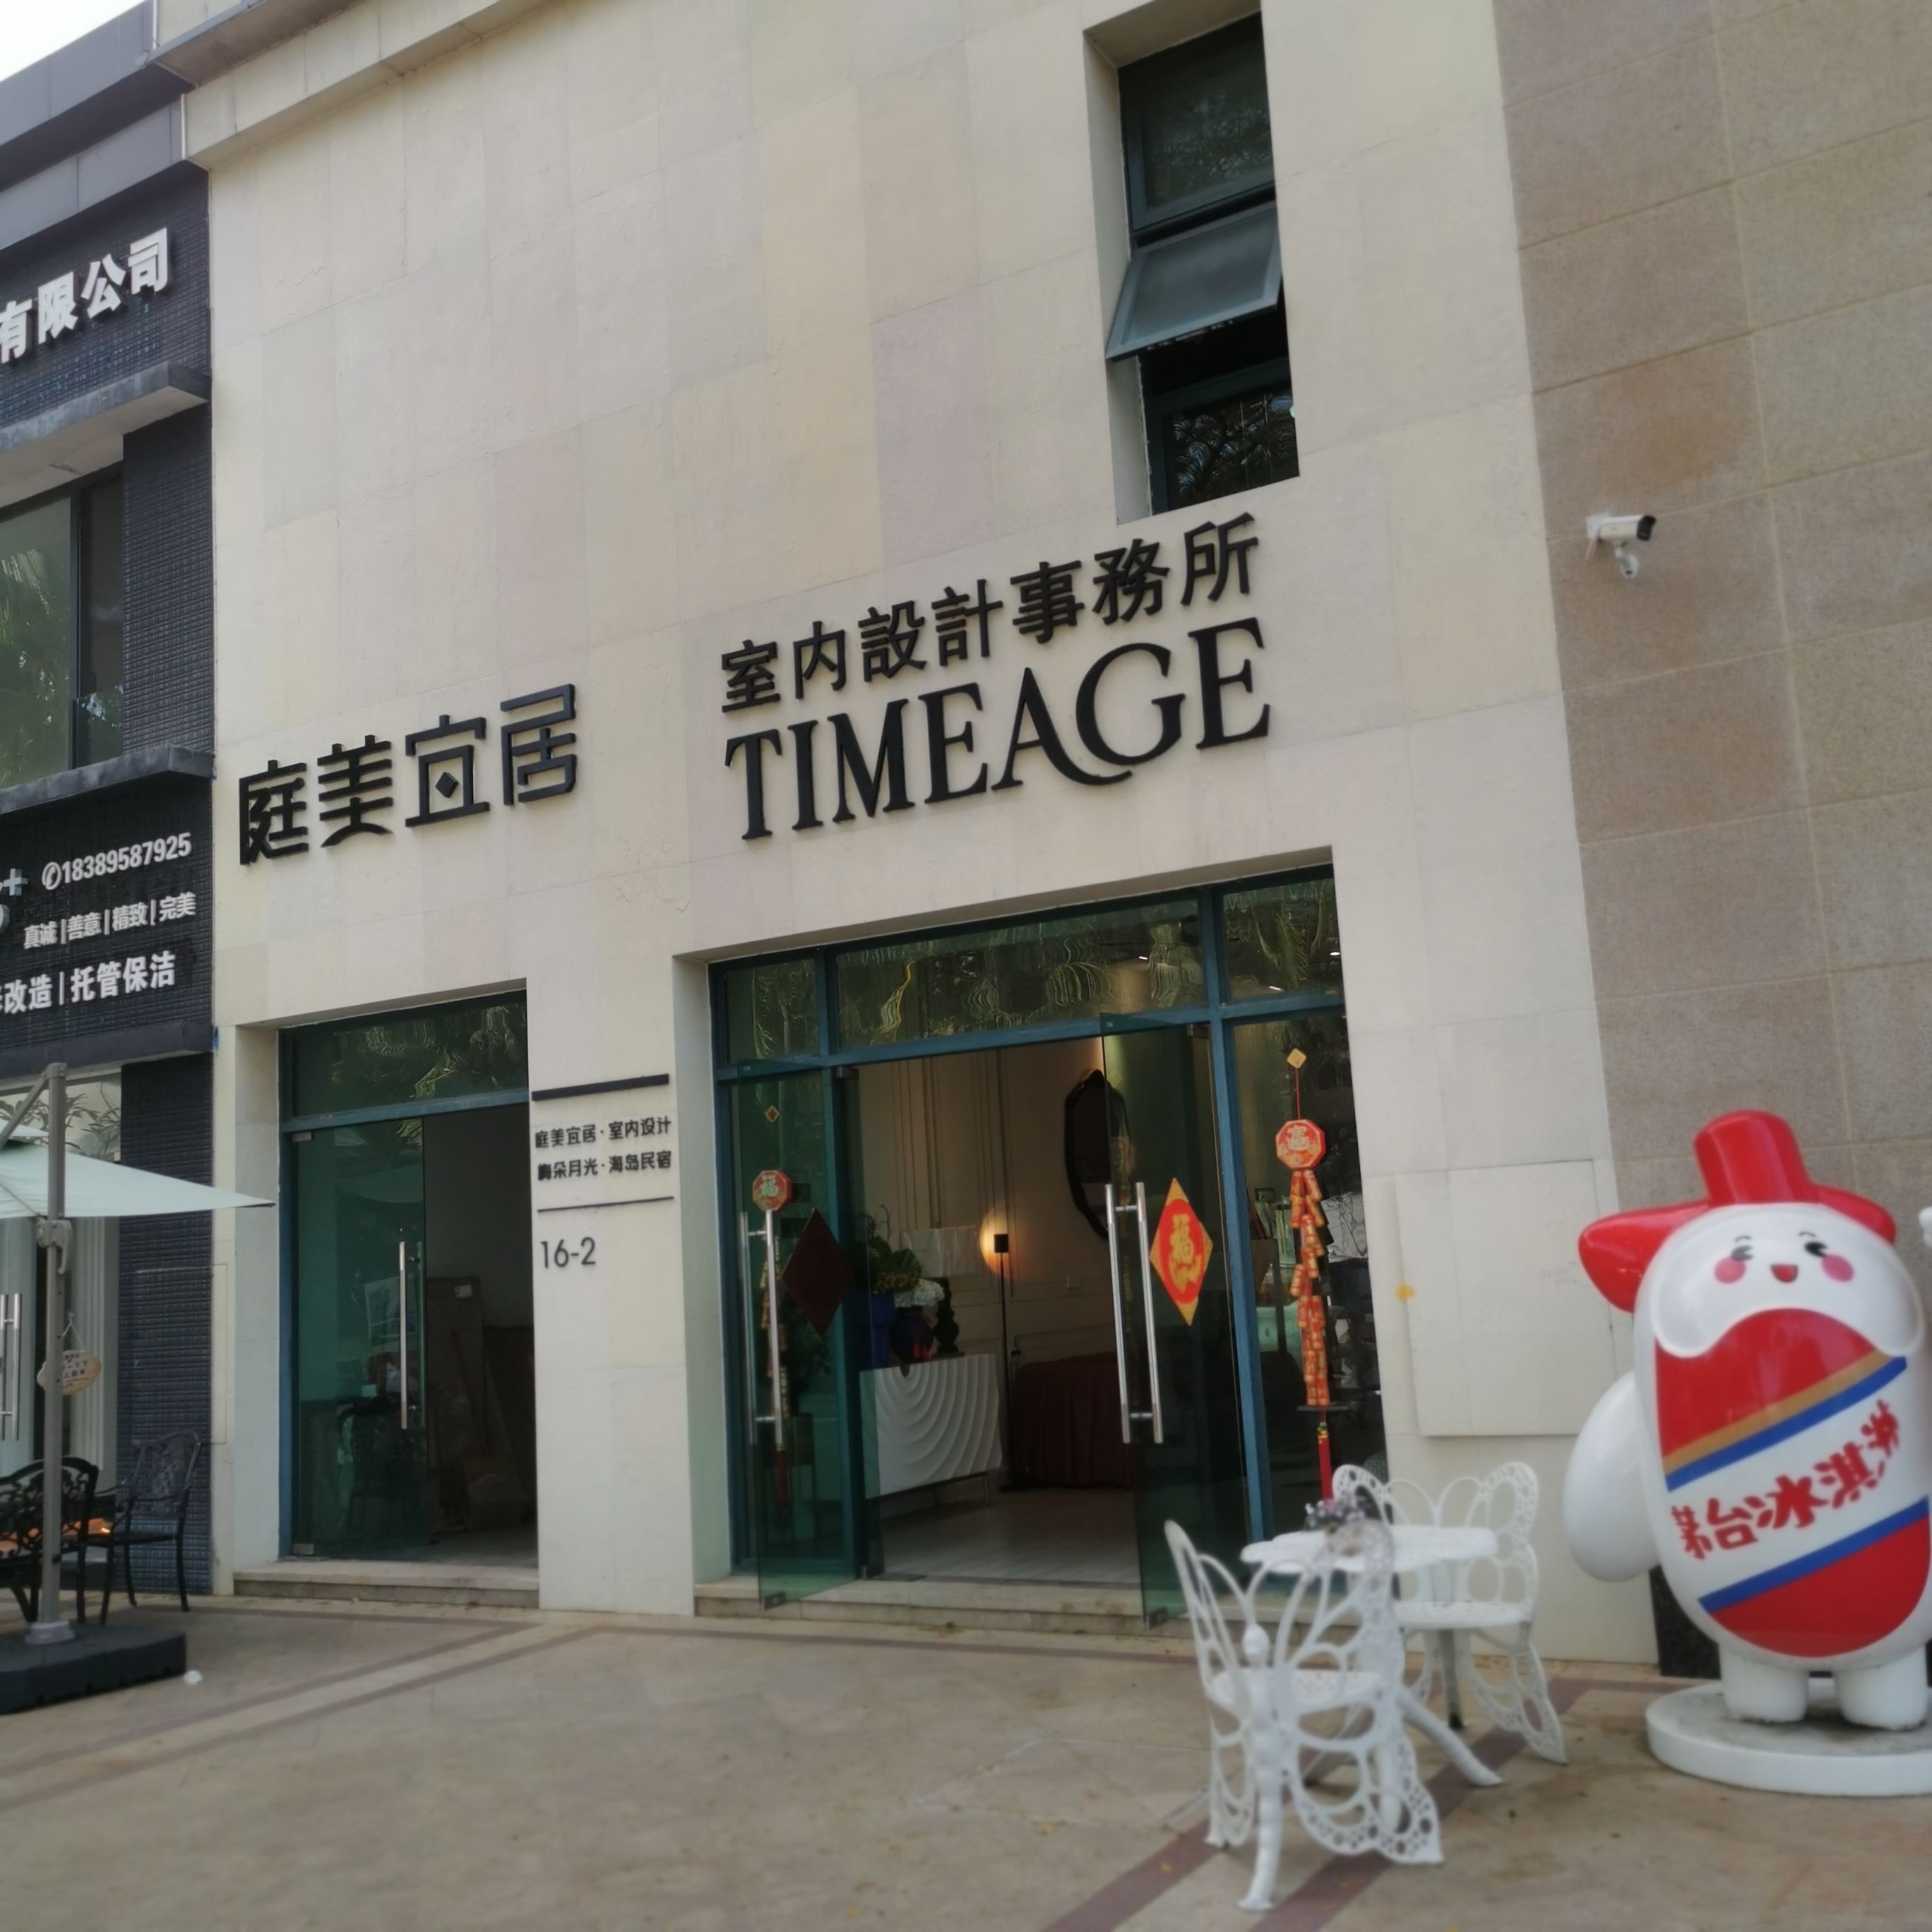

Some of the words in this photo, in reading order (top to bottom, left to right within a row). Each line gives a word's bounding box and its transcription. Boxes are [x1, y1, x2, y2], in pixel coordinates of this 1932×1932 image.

[0, 227, 168, 364] 有限公司
[722, 512, 1258, 712] 室内設計事務所
[239, 684, 576, 864] 庭美宜居
[725, 617, 1270, 840] TIMEAGE
[62, 833, 192, 883] 18389587925
[540, 1236, 596, 1269] 16-2
